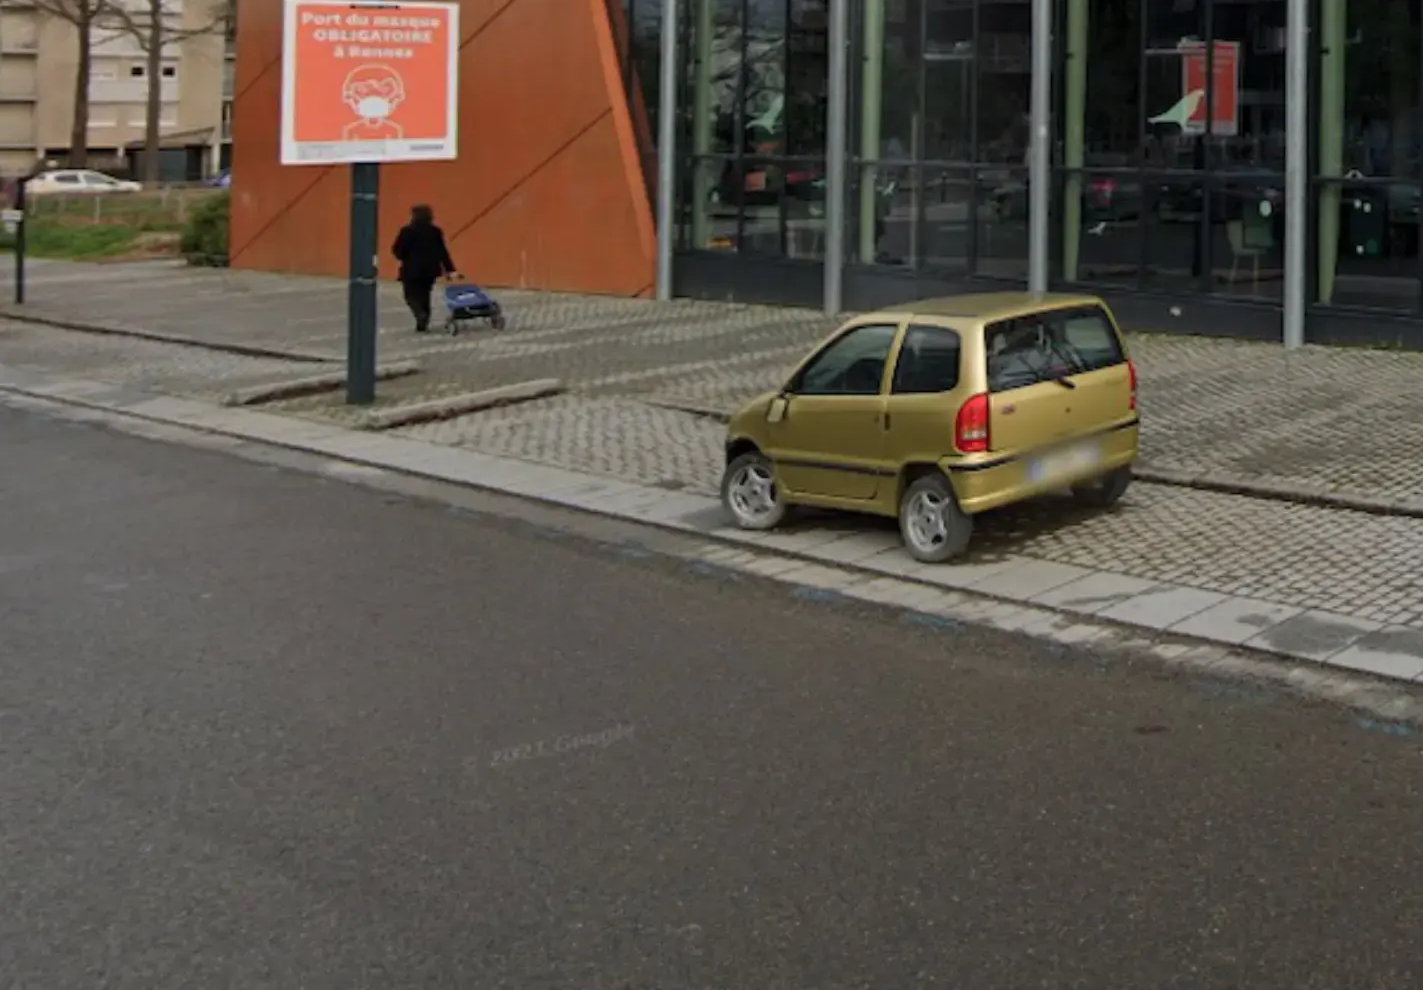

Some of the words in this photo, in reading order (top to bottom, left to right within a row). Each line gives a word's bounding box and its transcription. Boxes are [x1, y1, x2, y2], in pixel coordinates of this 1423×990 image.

[301, 12, 341, 26] Port
[345, 13, 369, 26] du
[373, 15, 442, 30] masque
[312, 28, 433, 44] OBLIGATOIRE
[348, 46, 414, 59] Rennes
